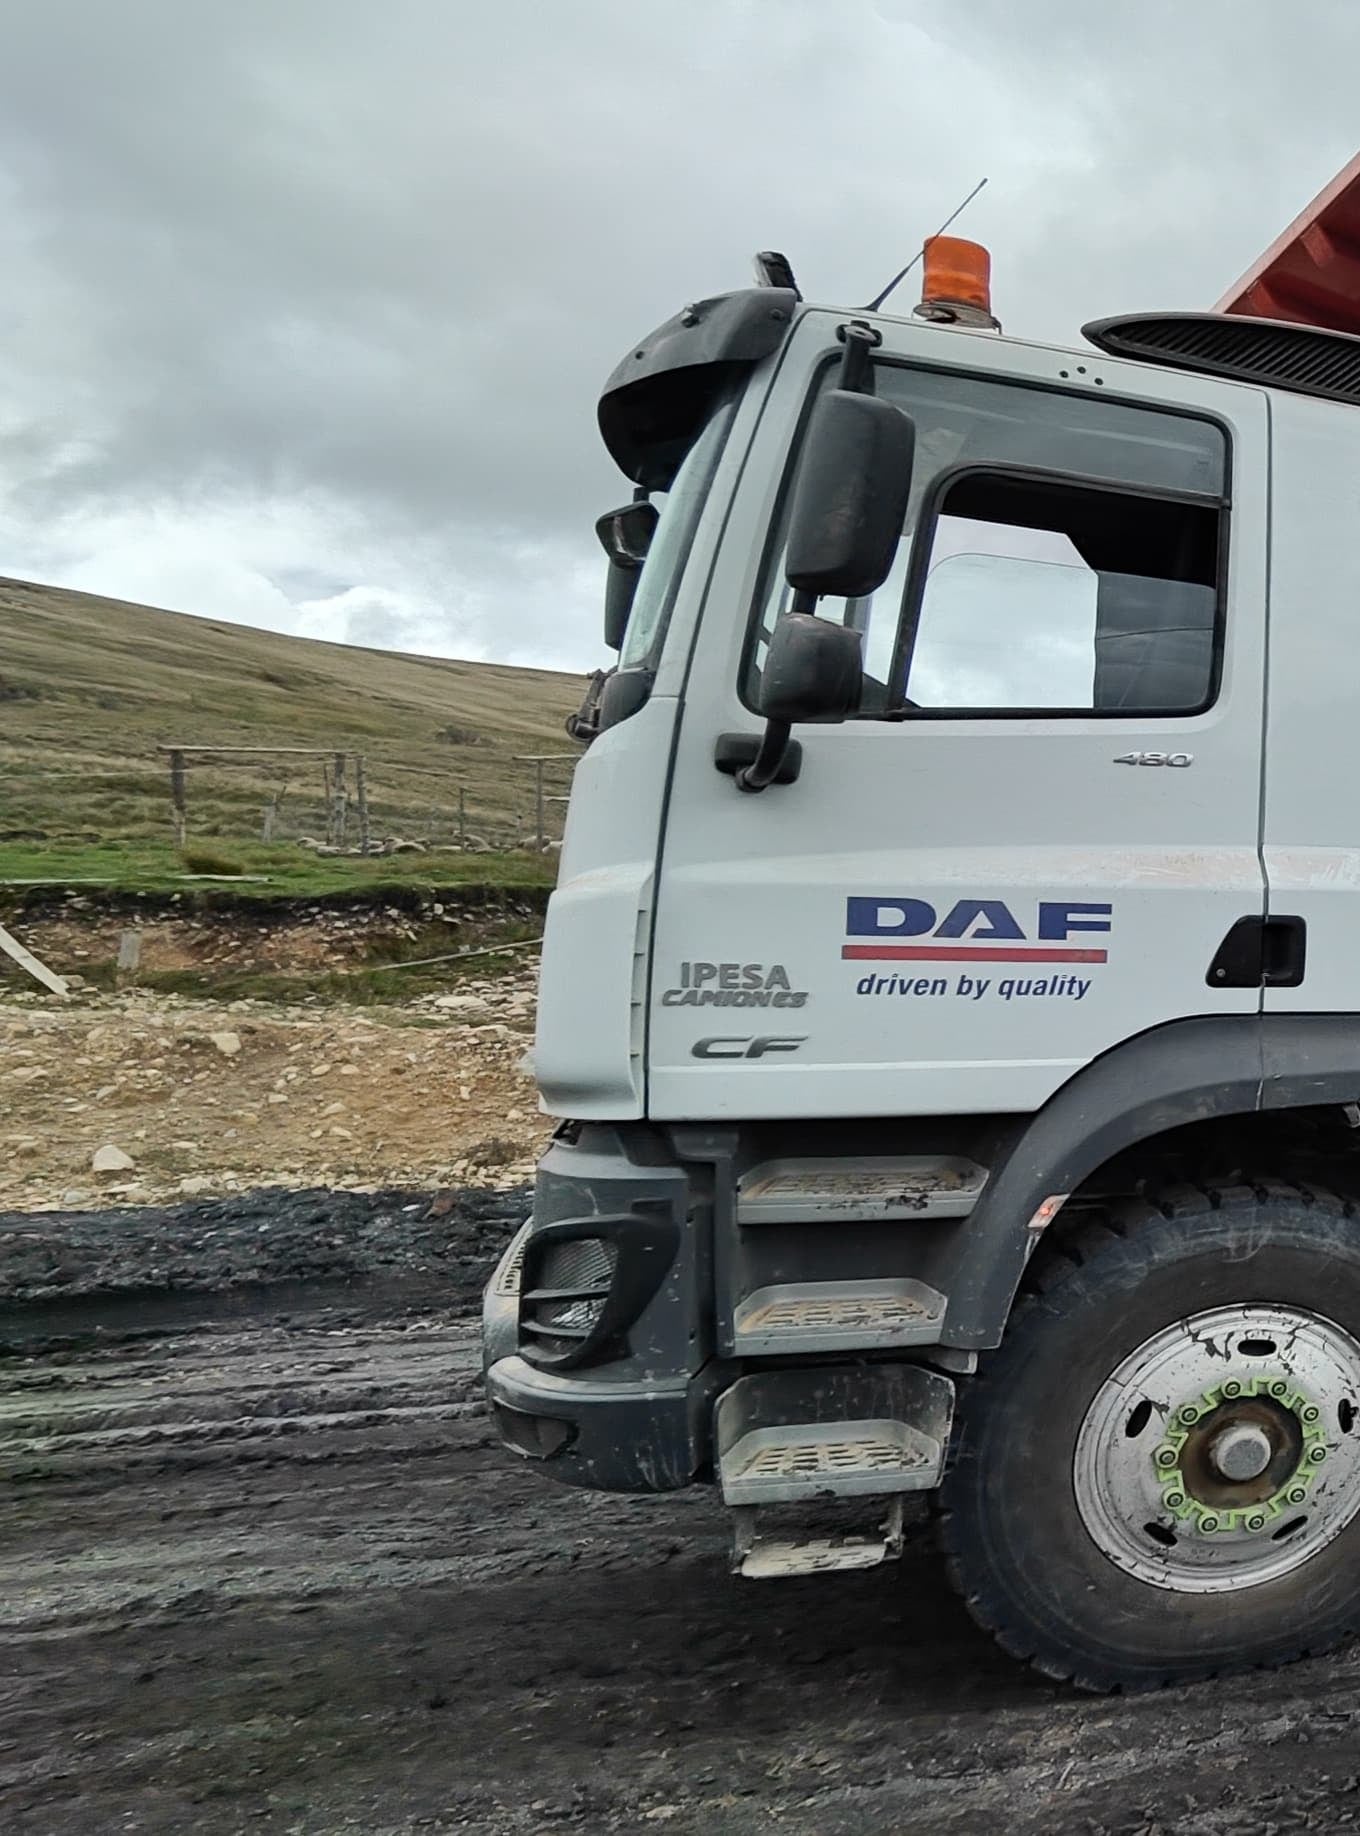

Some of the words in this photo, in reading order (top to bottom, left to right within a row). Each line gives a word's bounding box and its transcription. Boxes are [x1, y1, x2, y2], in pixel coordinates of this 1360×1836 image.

[1113, 752, 1193, 768] 480
[846, 896, 1112, 940] DAF
[680, 961, 791, 990] IPESA
[856, 973, 947, 996] driven
[956, 975, 991, 1000] by
[998, 974, 1092, 1000] quality
[662, 989, 809, 1008] CAMIONES
[691, 1034, 809, 1059] CF
